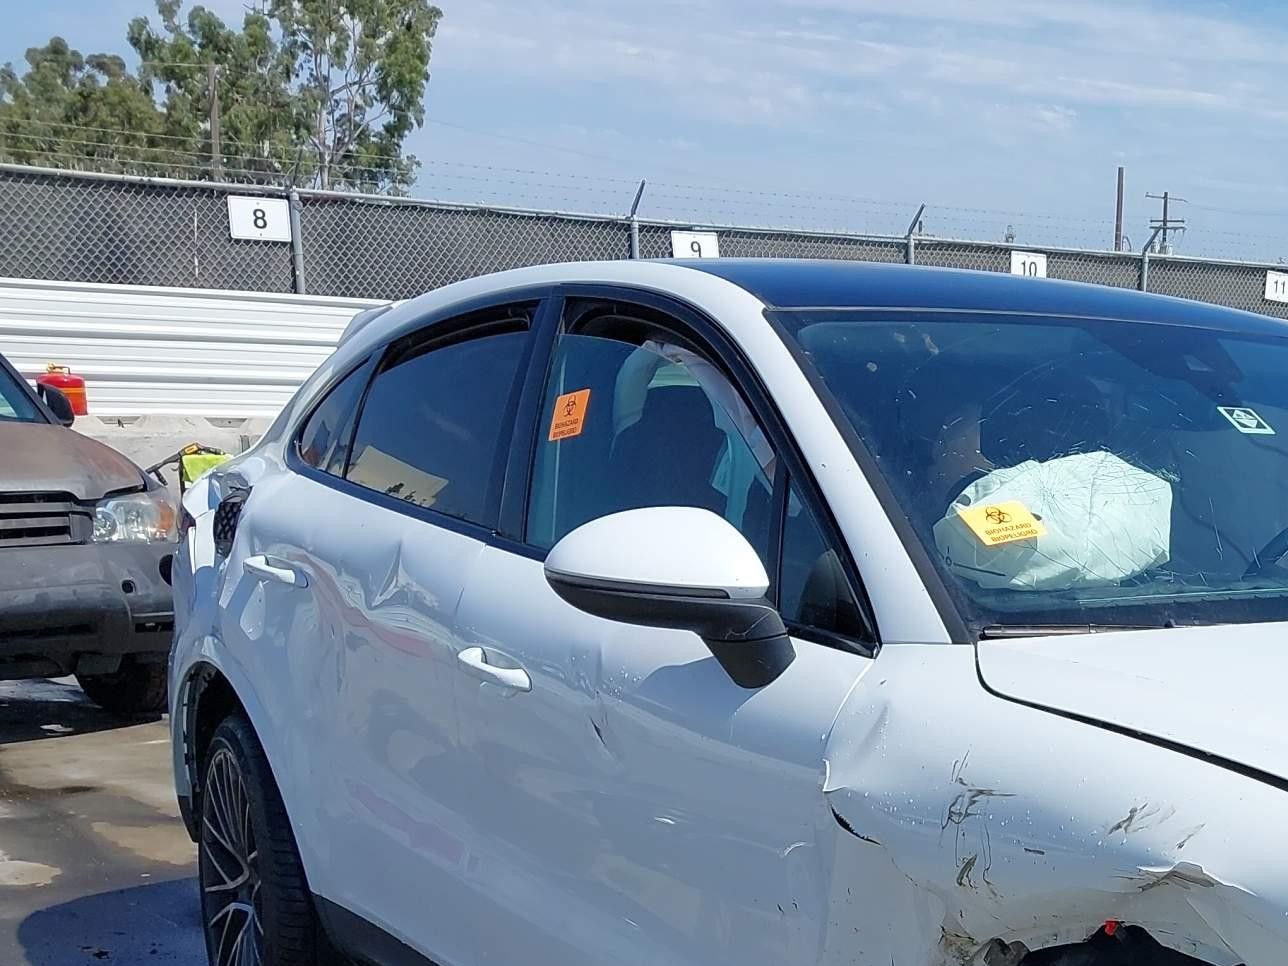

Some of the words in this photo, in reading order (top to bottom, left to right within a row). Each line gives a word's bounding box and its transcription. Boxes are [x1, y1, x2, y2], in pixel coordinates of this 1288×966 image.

[253, 208, 267, 230] 8
[690, 241, 702, 258] 9
[1021, 260, 1037, 277] 10
[1274, 279, 1286, 295] 11
[985, 522, 1032, 536] BIOHAZARD
[990, 529, 1038, 543] BIOPELIGRO
